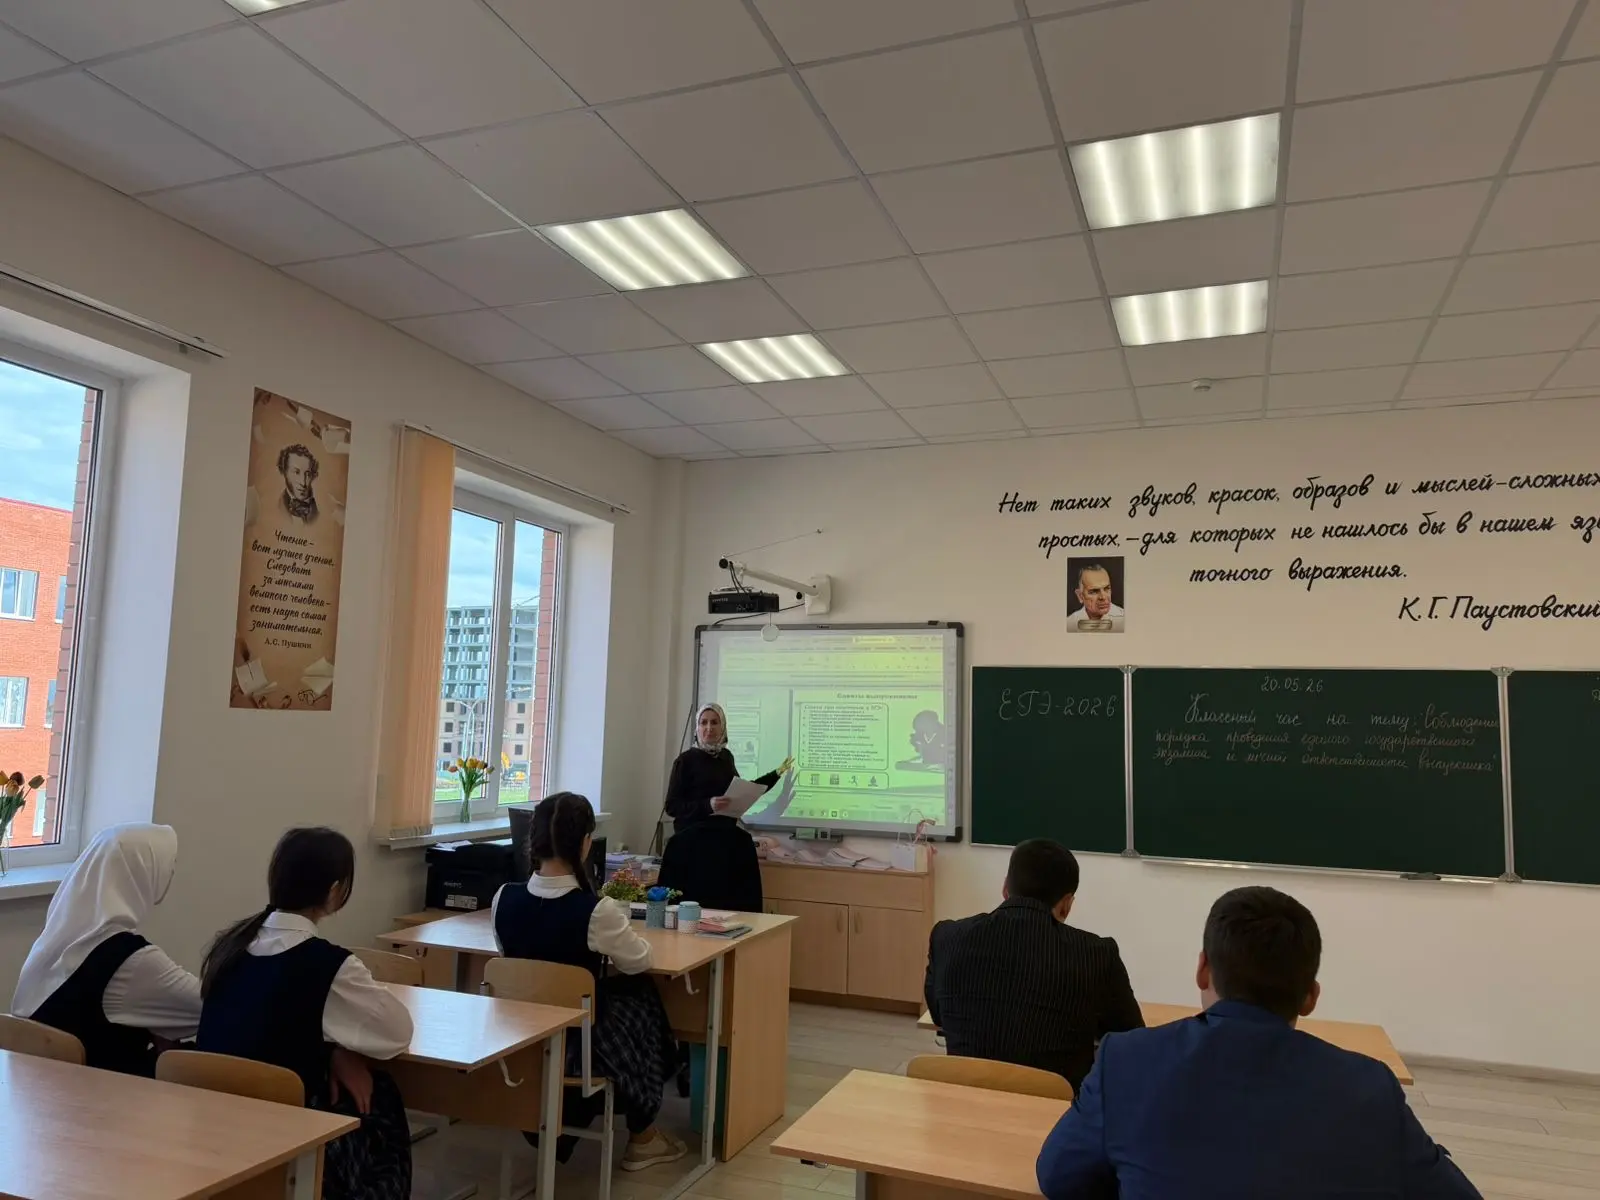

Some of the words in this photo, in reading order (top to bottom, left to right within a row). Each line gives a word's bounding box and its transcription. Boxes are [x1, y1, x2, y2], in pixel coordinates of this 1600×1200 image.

[999, 492, 1039, 512] Нет
[1050, 496, 1112, 511] таких
[1128, 482, 1196, 518] звуков,
[1292, 474, 1374, 511] образов
[1385, 480, 1404, 495] и
[1190, 527, 1275, 553] которых
[1290, 526, 1315, 539] не
[1321, 521, 1409, 538] нашлось
[1418, 511, 1446, 535] бы
[1456, 511, 1473, 534] в
[1479, 515, 1557, 533] нашем
[251, 540, 271, 555] вот
[272, 548, 303, 562] лучшее
[266, 558, 312, 576] Следовать
[1190, 566, 1274, 584] точного
[1288, 557, 1408, 592] выражения.
[261, 575, 272, 588] за
[249, 585, 289, 602] великого
[250, 604, 271, 615] есть
[273, 608, 299, 621] наука
[301, 611, 327, 622] самая
[1276, 713, 1302, 726] час
[1327, 714, 1350, 725] на
